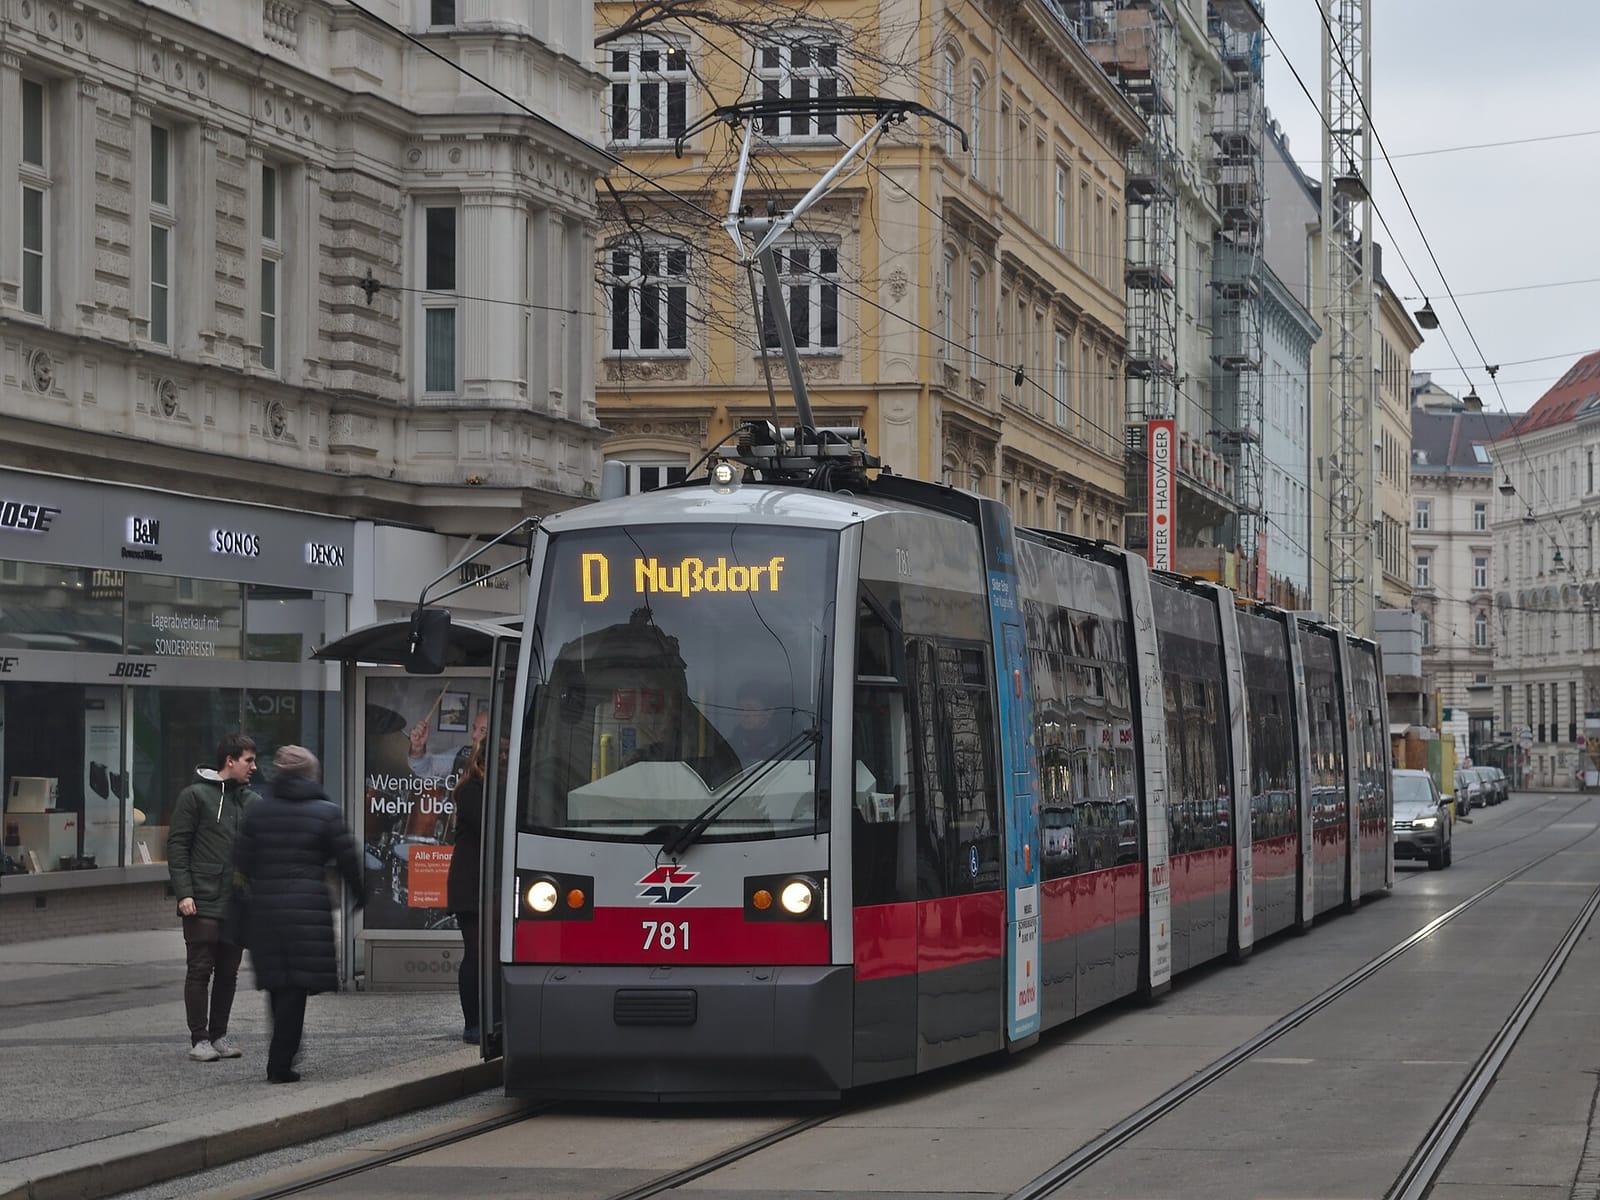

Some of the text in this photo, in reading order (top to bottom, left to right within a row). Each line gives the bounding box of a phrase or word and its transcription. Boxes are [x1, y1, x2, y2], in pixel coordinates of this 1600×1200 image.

[1155, 431, 1168, 510] HADWIGER
[131, 516, 160, 545] B&W
[214, 529, 260, 557] SONOS
[309, 543, 345, 567] DENON
[895, 547, 912, 577] 781
[582, 553, 785, 602] D Nußdorf
[151, 612, 220, 632] Lagerabverkauf mit
[155, 638, 215, 656] SONDERPREISEN
[109, 662, 157, 678] BOSE
[370, 774, 441, 796] Weniger
[370, 794, 455, 815] Mehr Übe
[415, 851, 431, 860] Alle
[642, 920, 690, 951] 781
